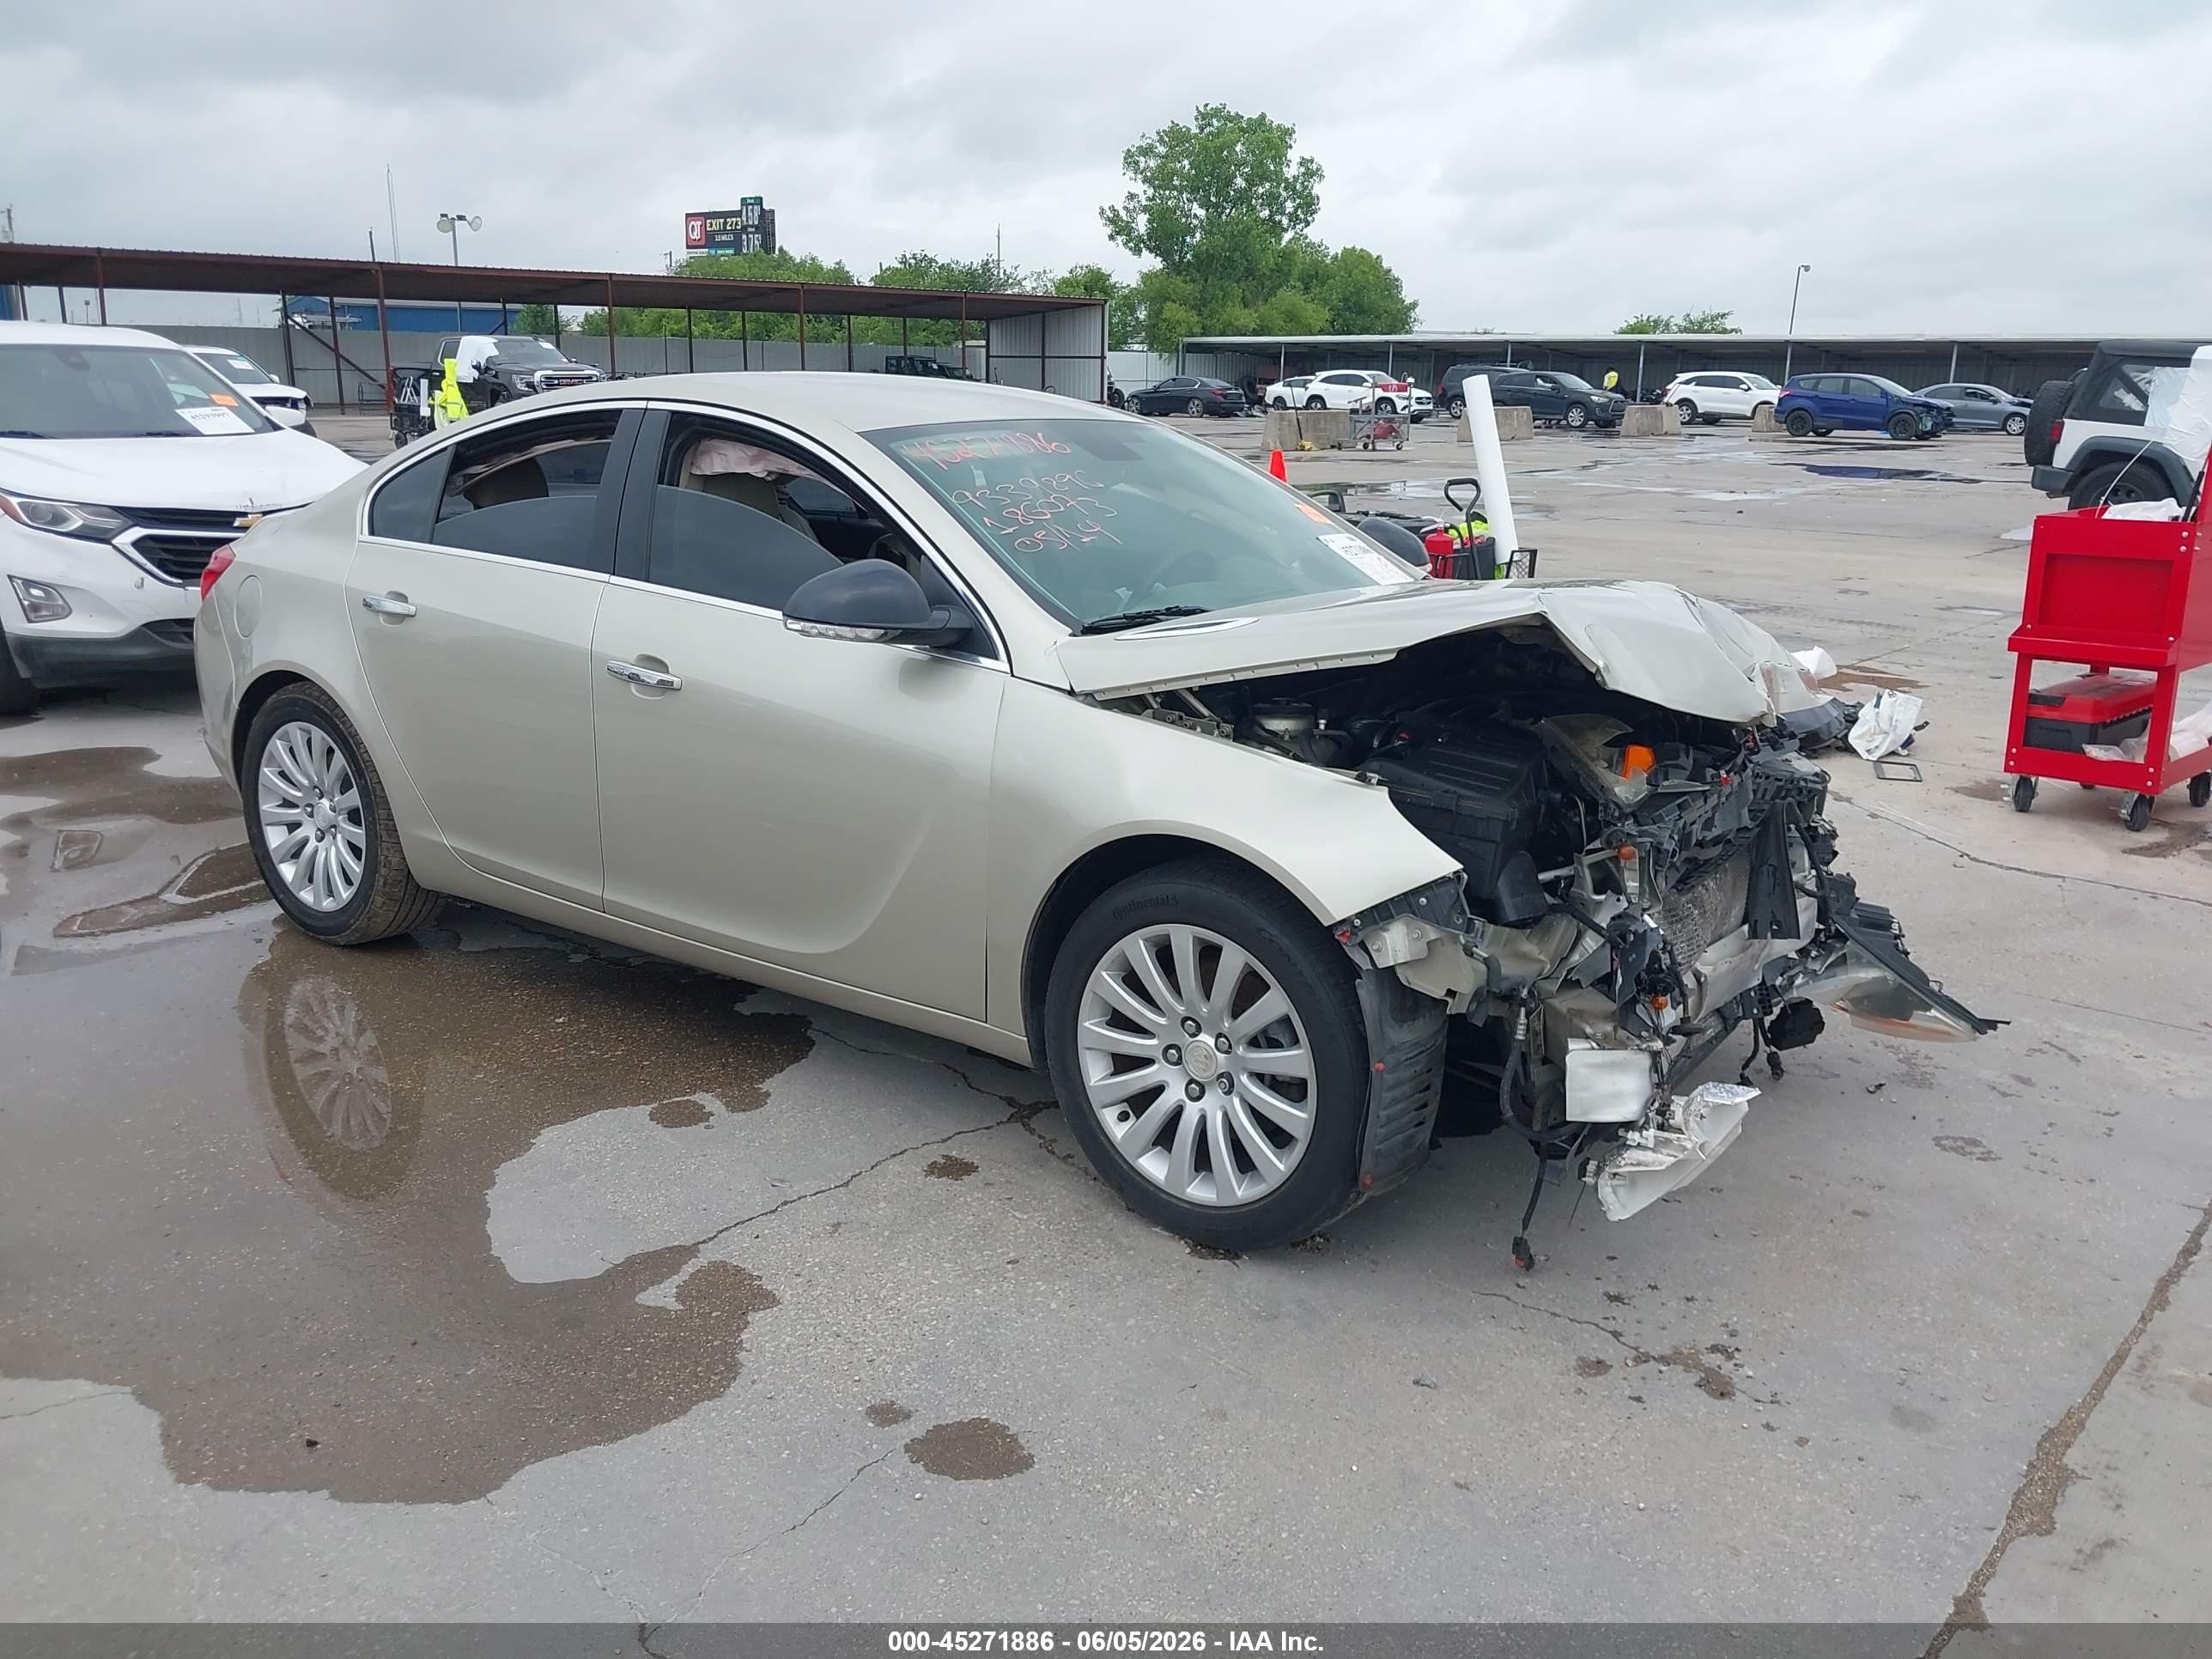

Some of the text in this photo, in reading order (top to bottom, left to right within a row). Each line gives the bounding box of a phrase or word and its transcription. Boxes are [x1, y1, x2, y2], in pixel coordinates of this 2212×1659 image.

[689, 221, 702, 241] QT
[706, 219, 724, 231] EXIT
[726, 217, 742, 230] 273
